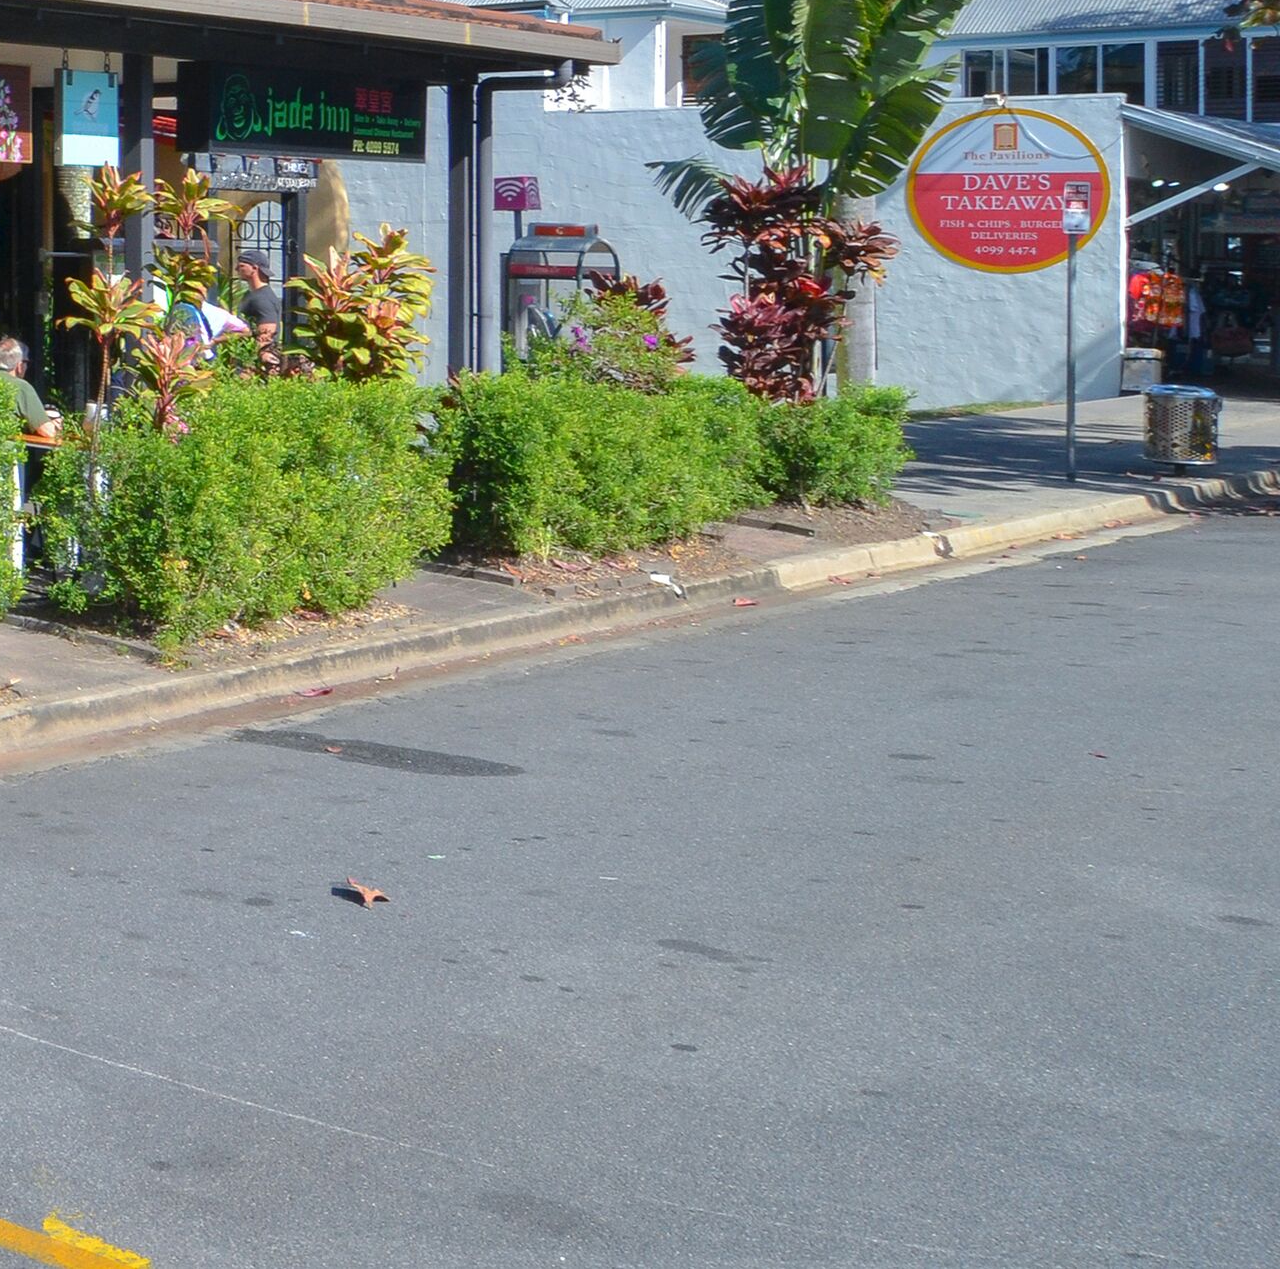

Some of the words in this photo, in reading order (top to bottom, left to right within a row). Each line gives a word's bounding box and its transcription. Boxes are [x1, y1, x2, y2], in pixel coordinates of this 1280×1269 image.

[265, 86, 314, 136] jade
[319, 90, 351, 133] inn
[963, 150, 988, 161] The
[989, 150, 1050, 161] Pavilions
[962, 174, 1051, 191] DAVE'S
[939, 219, 965, 228] FISH
[976, 219, 1011, 229] CHIPS
[971, 231, 1039, 241] DELIVERIES
[973, 246, 1004, 255] 4099
[1008, 246, 1037, 256] 4474
